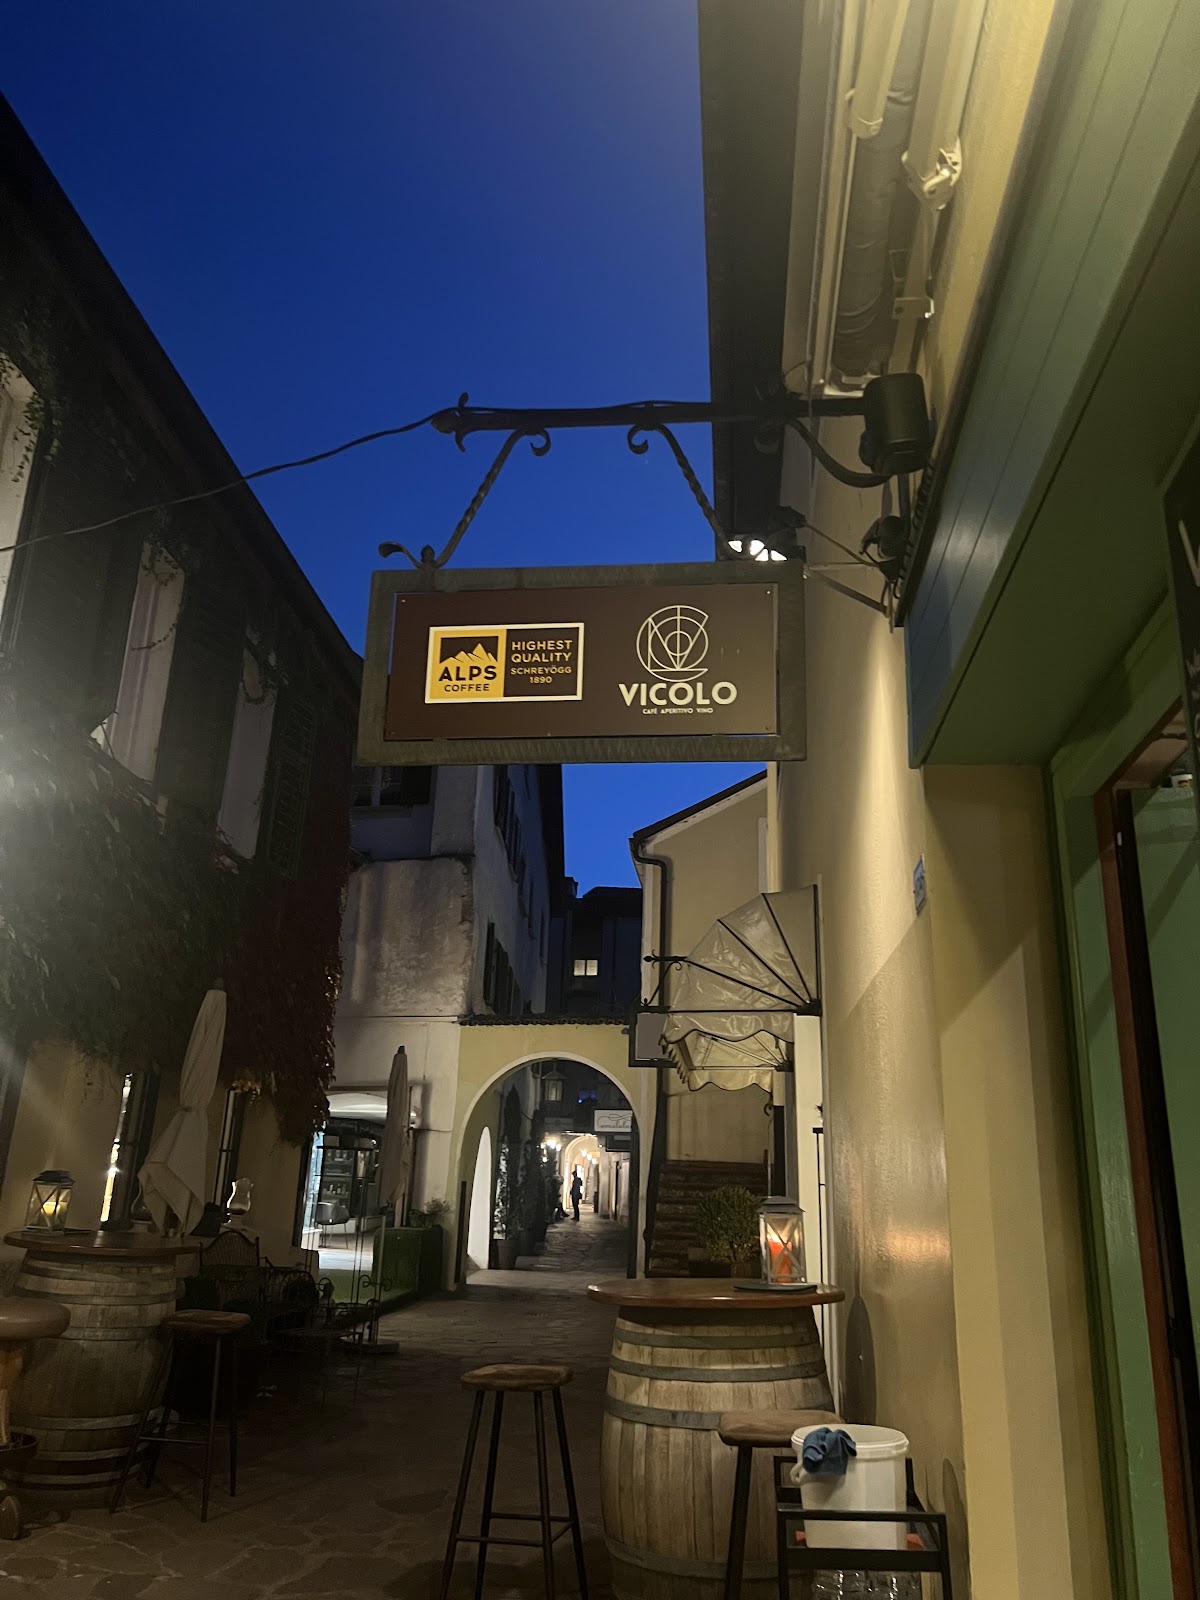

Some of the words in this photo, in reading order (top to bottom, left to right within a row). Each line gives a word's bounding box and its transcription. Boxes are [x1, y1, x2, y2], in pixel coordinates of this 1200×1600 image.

[511, 639, 573, 651] HIGHEST
[511, 652, 572, 663] QUALITY
[438, 665, 497, 682] ALPS
[510, 664, 572, 675] SCHREYÖGG
[529, 675, 553, 684] 1890
[444, 683, 490, 692] COFFEE
[618, 681, 738, 707] VICOLO
